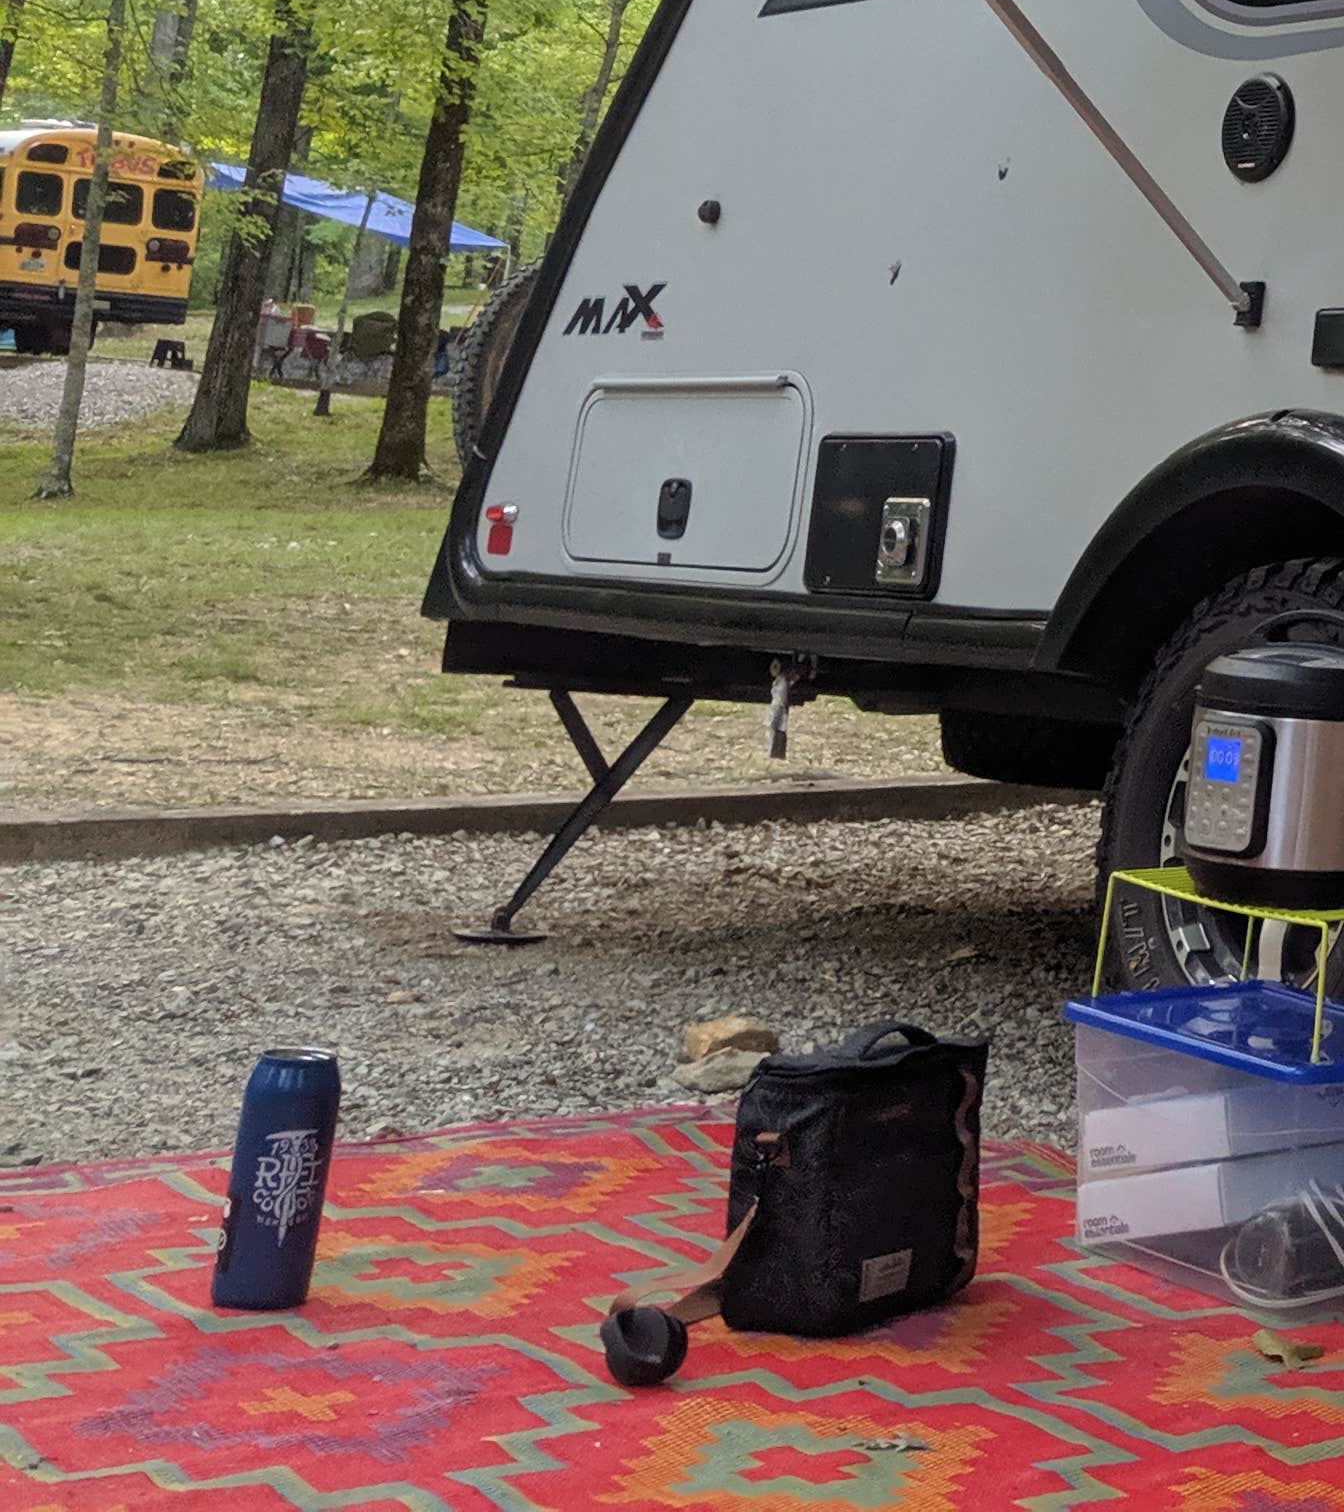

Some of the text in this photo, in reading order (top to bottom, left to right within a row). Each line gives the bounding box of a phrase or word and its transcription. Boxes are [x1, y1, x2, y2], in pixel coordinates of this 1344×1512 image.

[563, 283, 668, 336] MAX
[1089, 1145, 1114, 1158] room
[1091, 1152, 1136, 1168] essentials
[1083, 1215, 1107, 1228] room
[1085, 1222, 1130, 1238] essentials
